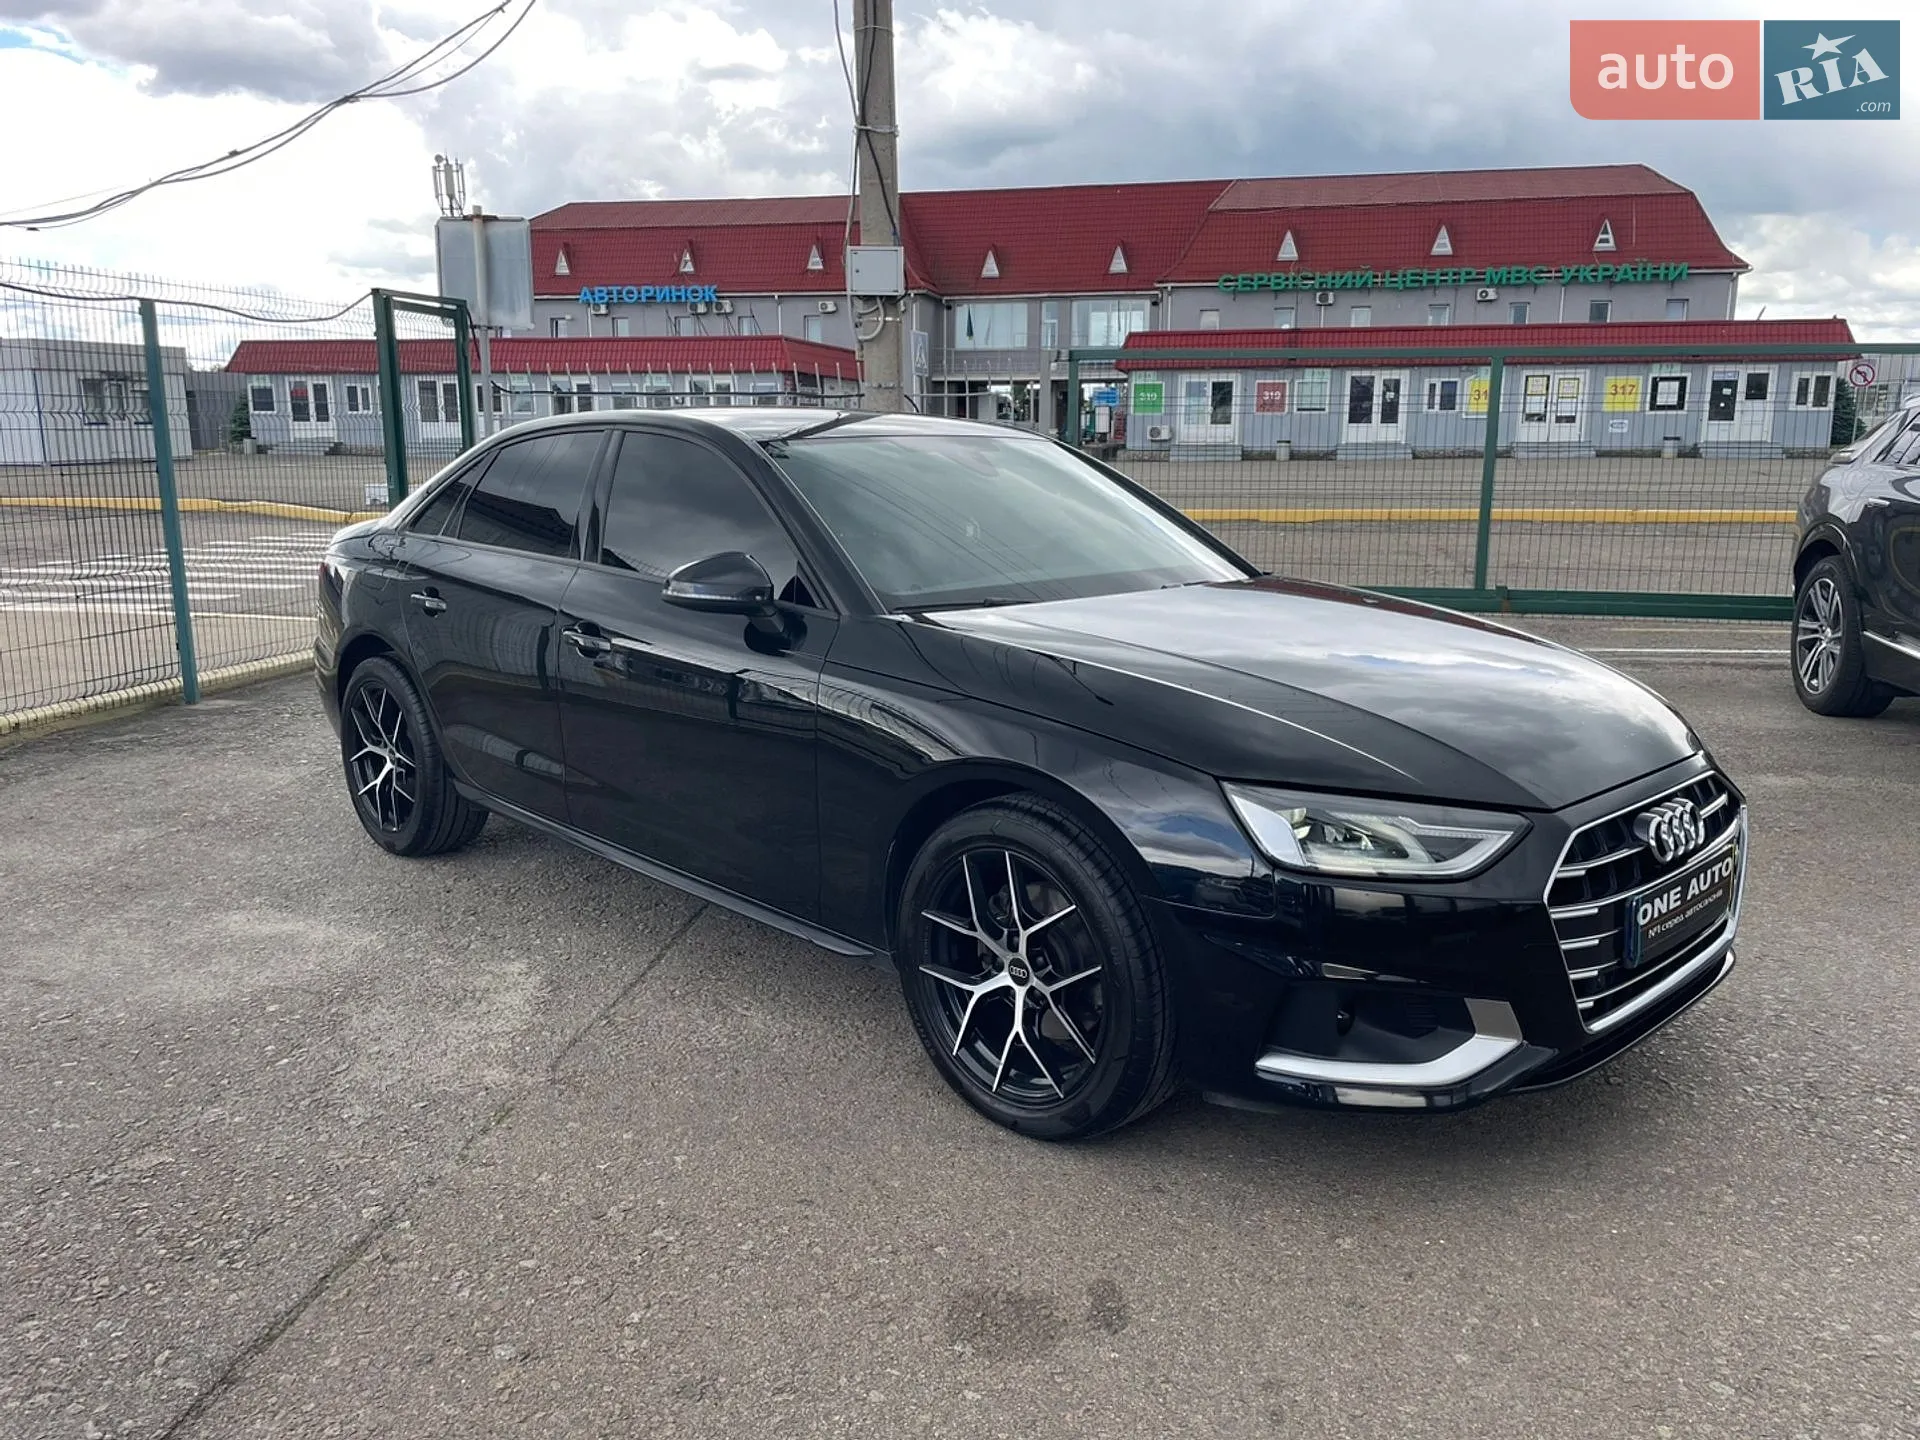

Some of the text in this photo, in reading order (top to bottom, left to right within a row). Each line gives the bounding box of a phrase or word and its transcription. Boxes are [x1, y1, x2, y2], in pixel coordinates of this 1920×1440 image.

[1217, 258, 1690, 293] СЕРВІСНИЙ ЦЕНТР МВС УКРАЇНИ
[579, 284, 718, 304] АВТОРИНОК
[1473, 389, 1488, 401] 31
[1610, 384, 1636, 396] 317
[1637, 856, 1733, 926] ONE AUTO
